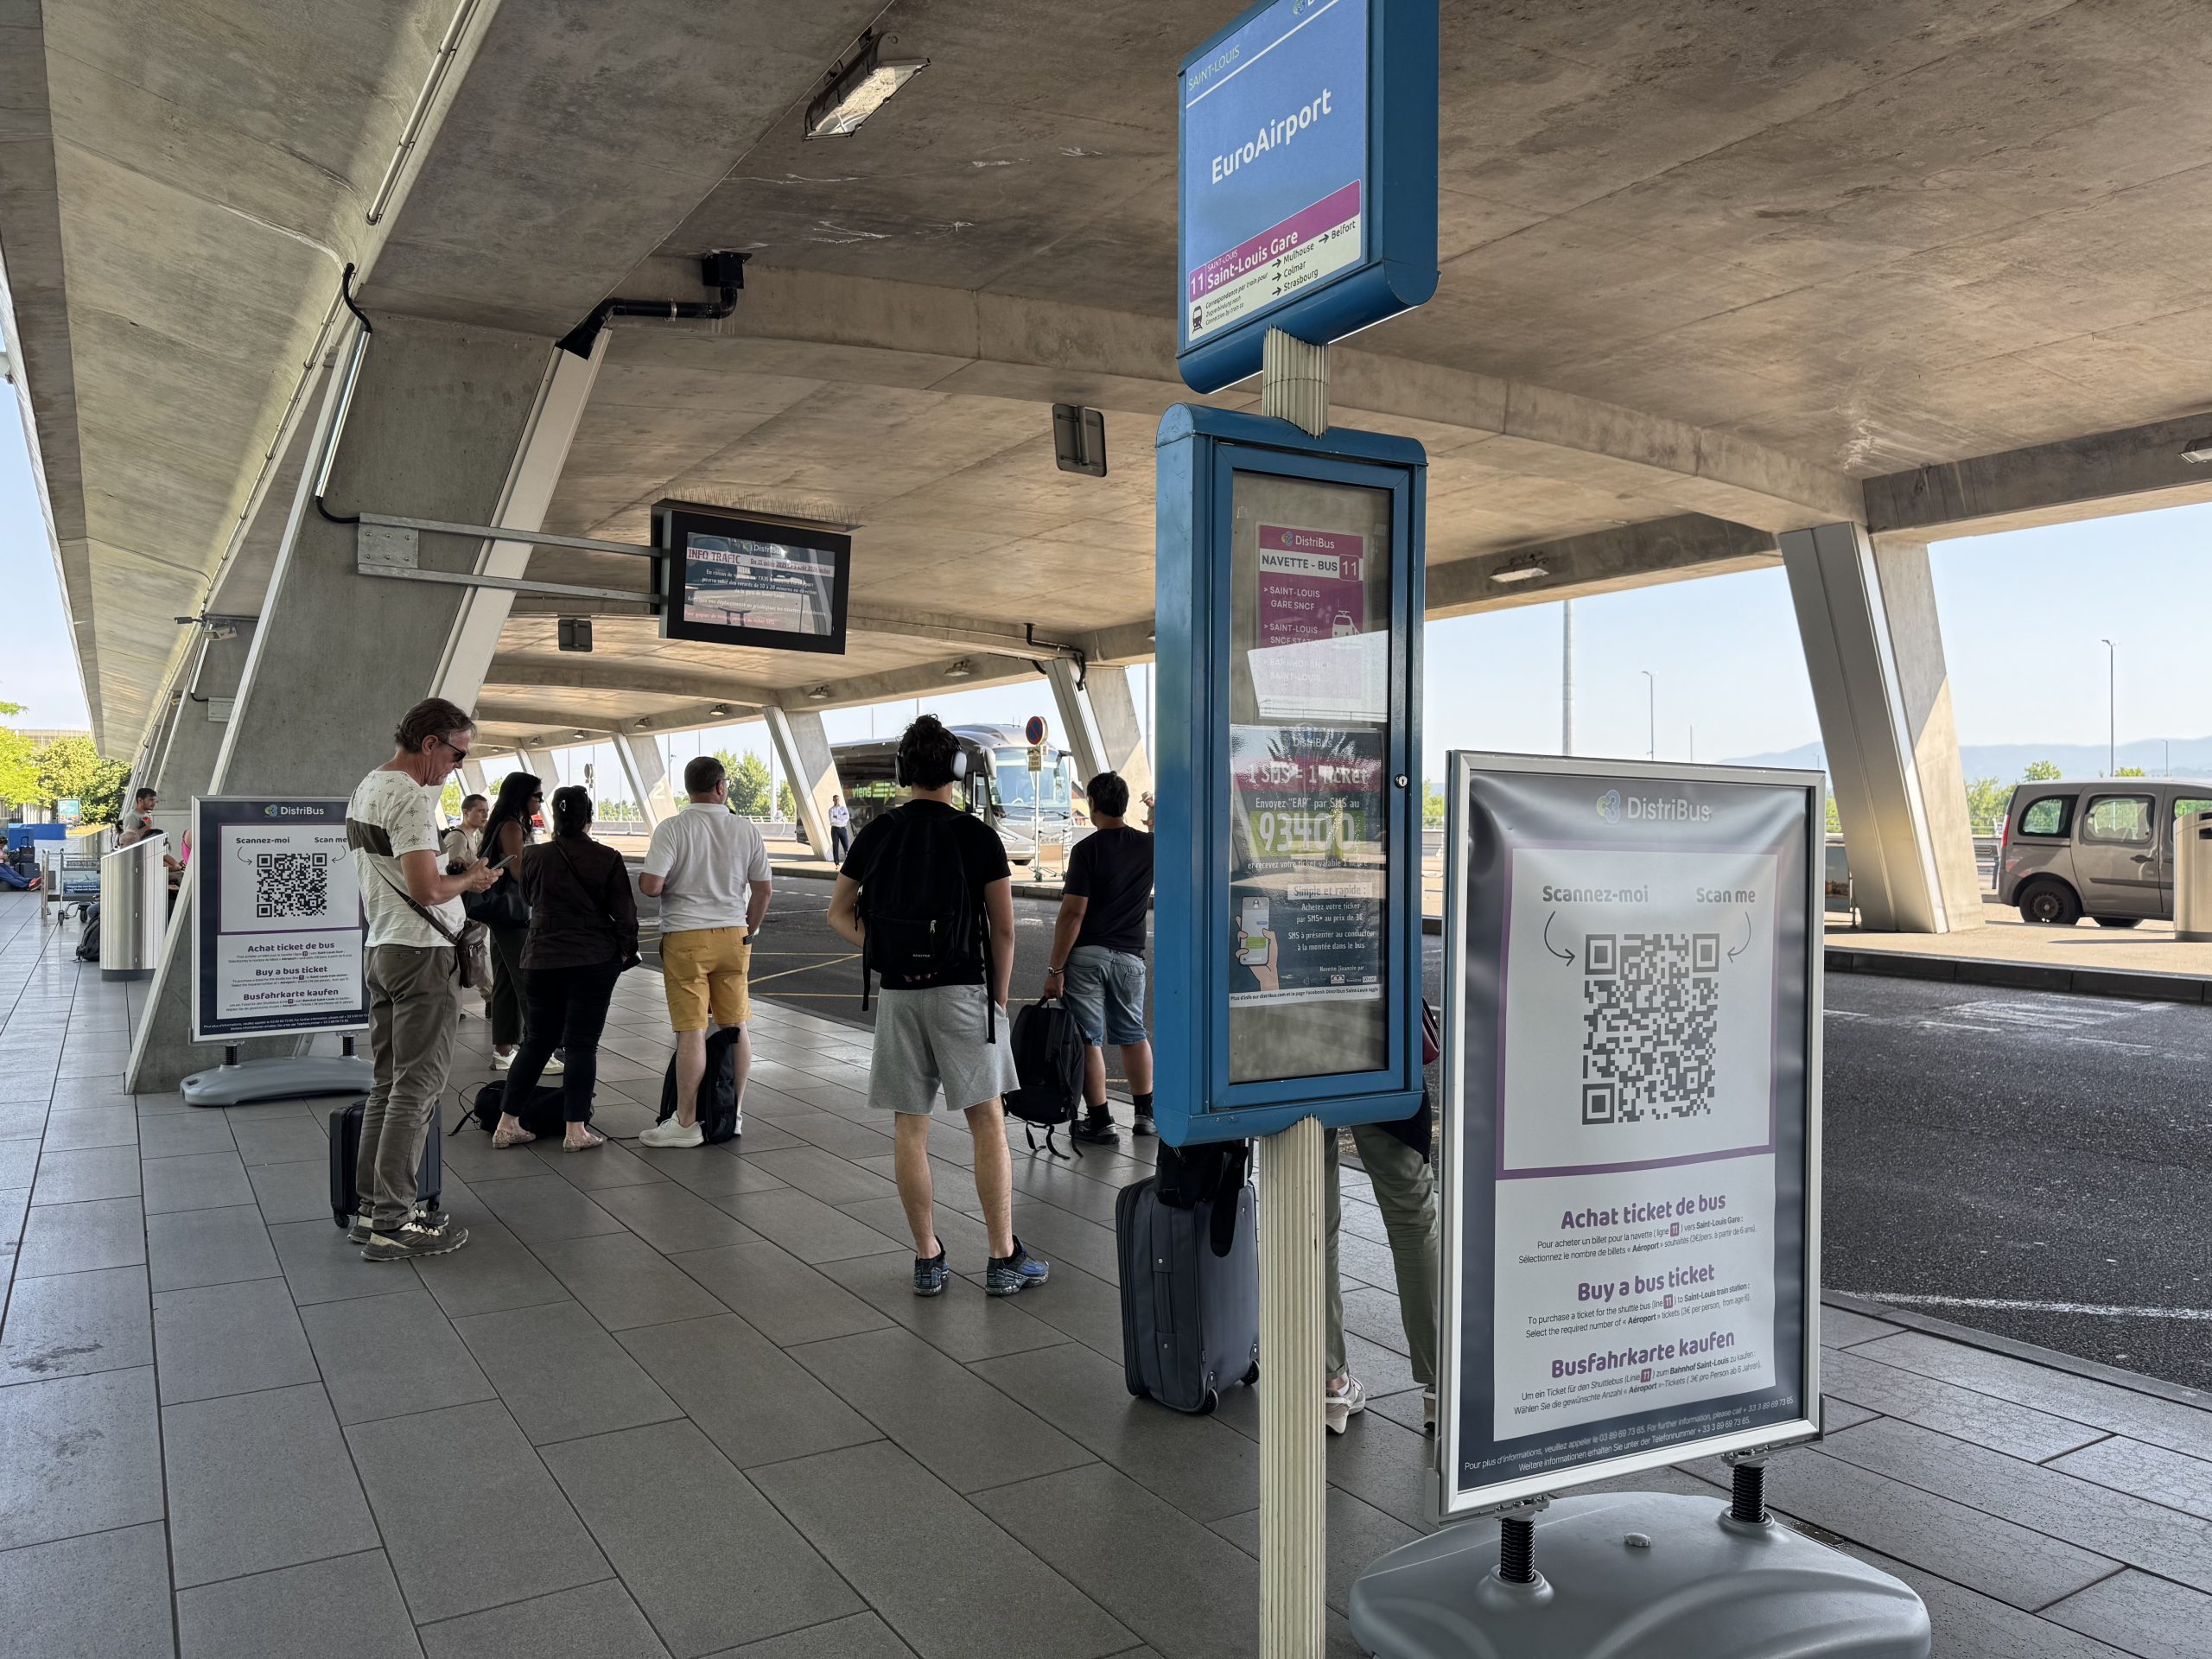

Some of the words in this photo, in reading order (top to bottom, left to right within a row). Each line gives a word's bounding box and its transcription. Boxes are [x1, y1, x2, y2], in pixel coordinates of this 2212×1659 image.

[1189, 45, 1240, 91] SAINT-LOUIS
[1211, 88, 1332, 185] EuroAirport
[1332, 220, 1356, 239] Belfort
[1207, 249, 1238, 271] SAINT-LOUIS
[1207, 245, 1268, 289] Saint-Louis
[1271, 231, 1298, 255] Gare
[1283, 243, 1314, 264] Mulhouse
[1283, 260, 1306, 278] Colmar
[1191, 273, 1204, 296] 11
[1283, 268, 1319, 292] Strasbourg
[1295, 535, 1335, 549] DistriBus
[688, 549, 709, 560] INFO
[712, 552, 741, 564] TRAFIC
[1262, 555, 1308, 569] NAVETTE
[1318, 560, 1338, 572] BUS
[1342, 561, 1357, 576] 11
[1269, 586, 1320, 598] SAINT-LOUIS
[1271, 600, 1293, 608] GARE
[1294, 601, 1315, 611] SNCF
[1269, 623, 1318, 634] SAINT-LOUIS
[280, 805, 325, 816] DistriBus
[1255, 798, 1286, 812] Envoyez
[1313, 800, 1327, 813] par
[1350, 799, 1359, 808] au
[1627, 797, 1712, 822] DistriBus
[1260, 811, 1355, 852] 93400
[1294, 886, 1321, 899] Simple
[1324, 887, 1333, 895] et
[1335, 885, 1363, 898] rapide
[1542, 885, 1649, 904] Scannez-moi
[1696, 887, 1732, 904] Scan
[1734, 888, 1755, 904] me
[1288, 931, 1300, 940] SMS
[1300, 931, 1305, 939] à
[1306, 931, 1333, 940] présenter
[247, 944, 275, 953] Achat
[276, 943, 304, 952] ticket
[305, 942, 318, 950] de
[319, 941, 335, 950] bus
[1297, 943, 1300, 951] à
[1301, 942, 1308, 950] la
[1308, 941, 1331, 950] montée
[1332, 942, 1346, 950] dans
[256, 969, 274, 978] Buy
[283, 967, 301, 976] bus
[302, 965, 328, 975] ticket
[243, 991, 306, 1001] Busfahrkarte
[307, 988, 339, 997] kaufen
[1560, 1208, 1618, 1229] Achat
[1623, 1201, 1672, 1224] ticket
[1675, 1197, 1694, 1216] de
[1698, 1193, 1726, 1211] bus
[1537, 1240, 1553, 1249] Pour
[1554, 1238, 1580, 1247] acheter
[1607, 1235, 1623, 1244] pour
[1630, 1231, 1652, 1240] navette
[1656, 1228, 1669, 1237] ligne
[1672, 1224, 1678, 1234] 11
[1695, 1218, 1726, 1229] Saint-Louis
[1518, 1253, 1561, 1263] Sélectionnez
[1570, 1249, 1596, 1258] nombre
[1631, 1242, 1658, 1252] Aéroport
[1578, 1282, 1614, 1302] Buy
[1618, 1281, 1629, 1296] a
[1634, 1274, 1664, 1294] bus
[1669, 1263, 1714, 1287] ticket
[1538, 1313, 1569, 1325] purchase
[1576, 1310, 1594, 1319] ticket
[1595, 1307, 1605, 1316] for
[1605, 1306, 1617, 1315] the
[1618, 1304, 1638, 1313] shuttle
[1684, 1288, 1715, 1301] Saint-Louis
[1729, 1283, 1746, 1293] station
[1525, 1328, 1547, 1338] Select
[1560, 1323, 1587, 1334] required
[1589, 1320, 1613, 1330] number
[1614, 1317, 1621, 1326] of
[1627, 1313, 1656, 1325] Aéroport
[1662, 1309, 1680, 1319] tickets
[1691, 1306, 1700, 1314] per
[1551, 1344, 1675, 1378] Busfahrkarte
[1679, 1331, 1734, 1357] kaufen
[1535, 1389, 1544, 1398] ein
[1546, 1387, 1566, 1396] Ticket
[1567, 1384, 1576, 1393] für
[1591, 1377, 1623, 1389] Shuttlebus
[1669, 1362, 1695, 1374] Bahnhof
[1696, 1357, 1729, 1370] Saint-Louis
[1513, 1404, 1539, 1414] Wählen
[1540, 1402, 1550, 1410] Sie
[1562, 1393, 1600, 1408] gewünschte
[1601, 1389, 1622, 1399] Anzahl
[1628, 1382, 1656, 1394] Aéroport
[1689, 1374, 1698, 1382] 3€
[1699, 1373, 1709, 1382] pro
[1709, 1370, 1729, 1379] Person
